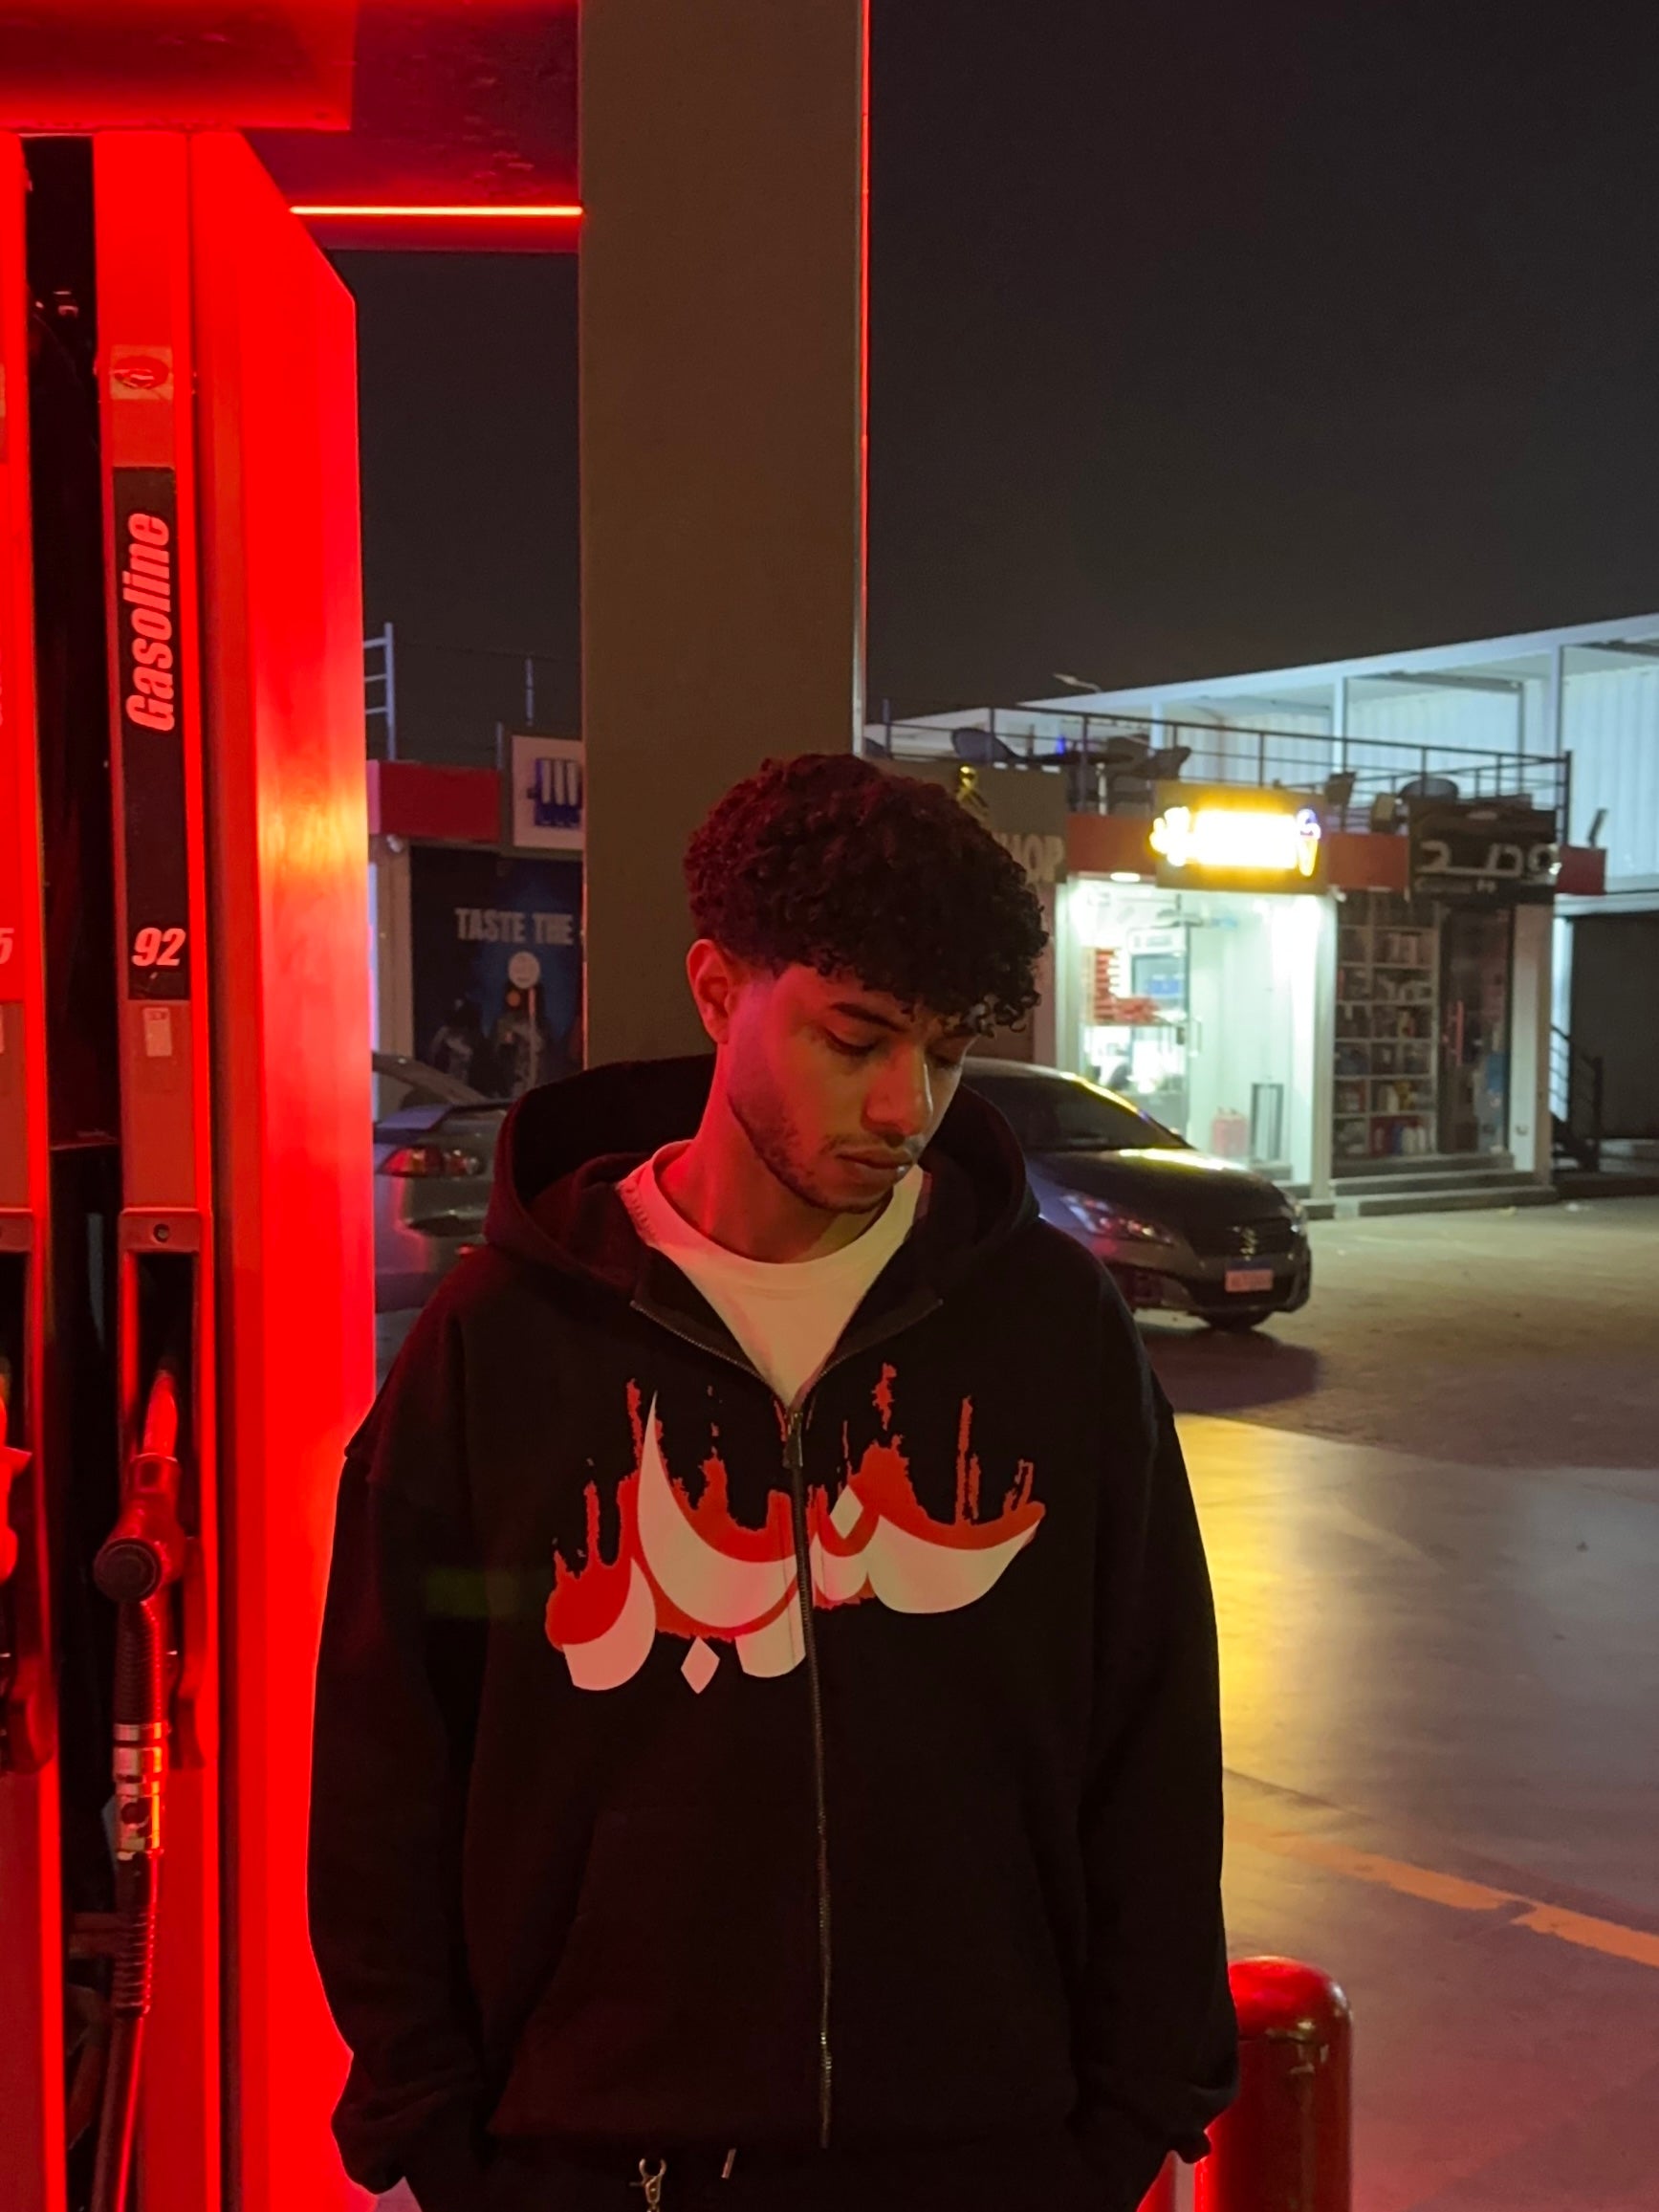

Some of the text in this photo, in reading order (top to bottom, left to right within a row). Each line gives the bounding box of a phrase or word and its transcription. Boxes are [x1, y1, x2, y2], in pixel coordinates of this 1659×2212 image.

[123, 513, 175, 732] Gasoline
[454, 908, 573, 945] TASTE THE
[132, 927, 186, 967] 92
